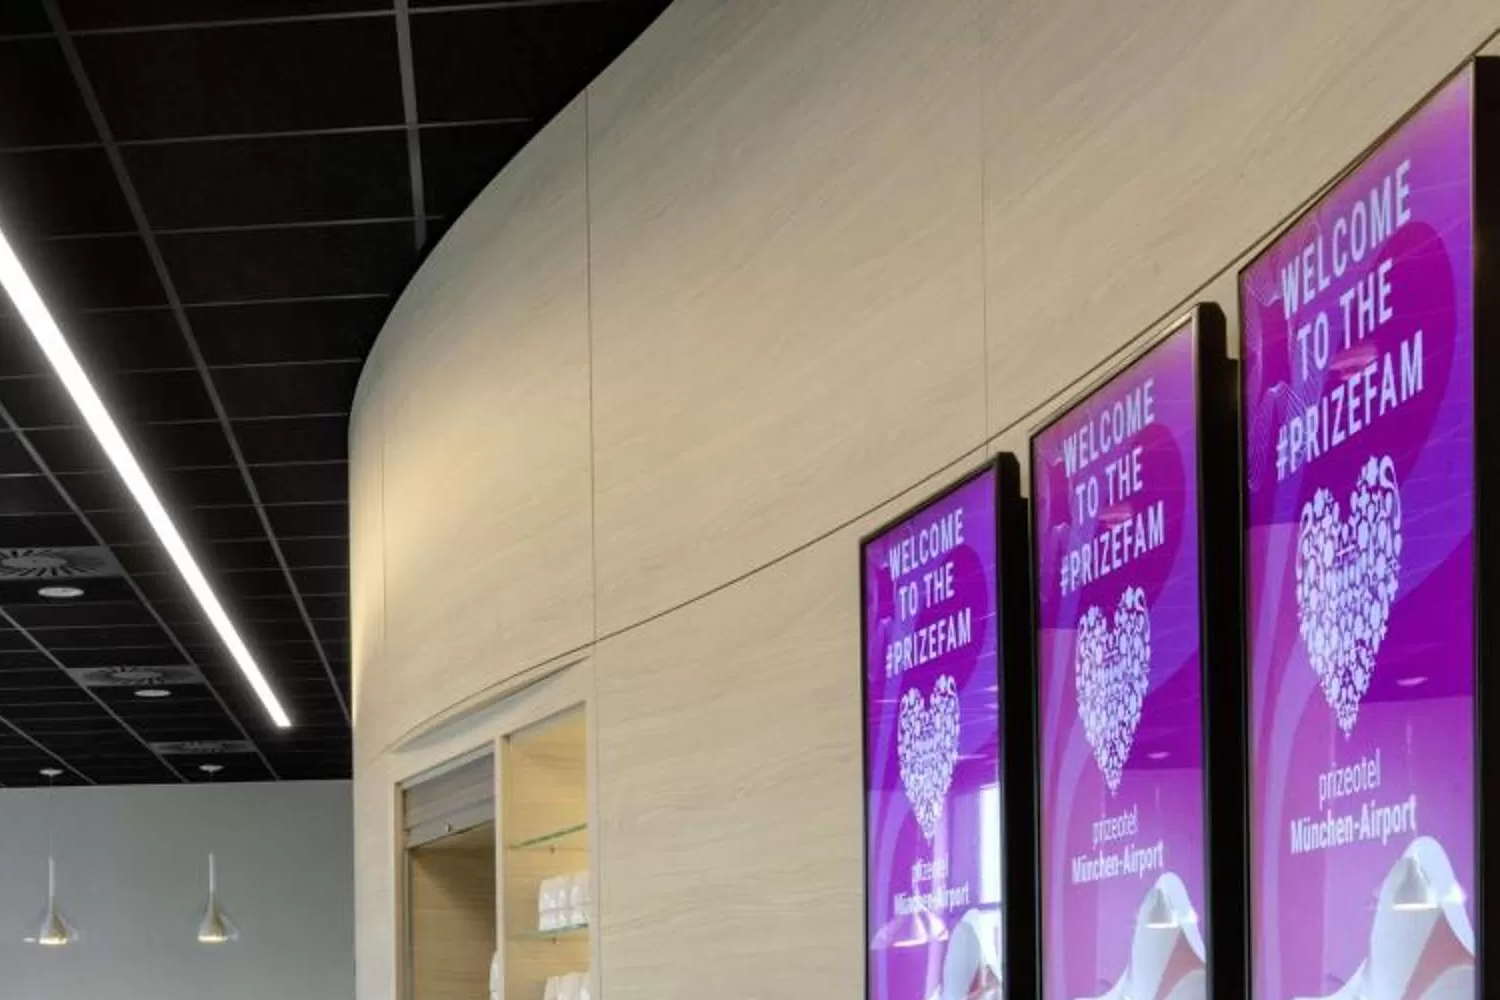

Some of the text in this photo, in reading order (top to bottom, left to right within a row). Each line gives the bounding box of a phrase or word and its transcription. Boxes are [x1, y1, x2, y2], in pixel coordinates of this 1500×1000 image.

[1281, 158, 1412, 321] WELCOME
[1297, 257, 1393, 382] TO THE
[1063, 377, 1155, 479] WELCOME
[1275, 329, 1424, 481] #PRIZEFAM
[1075, 446, 1143, 526] TO THE
[889, 508, 965, 582] WELCOME
[1059, 500, 1165, 598] #PRIZEFAM
[899, 561, 955, 622] TO THE
[885, 607, 972, 679] #PRIZEFAM
[1318, 747, 1381, 812] prizeotel
[1091, 803, 1138, 851] prizeotel
[1290, 793, 1417, 856] München-Airport
[1071, 838, 1164, 886] München-Airport
